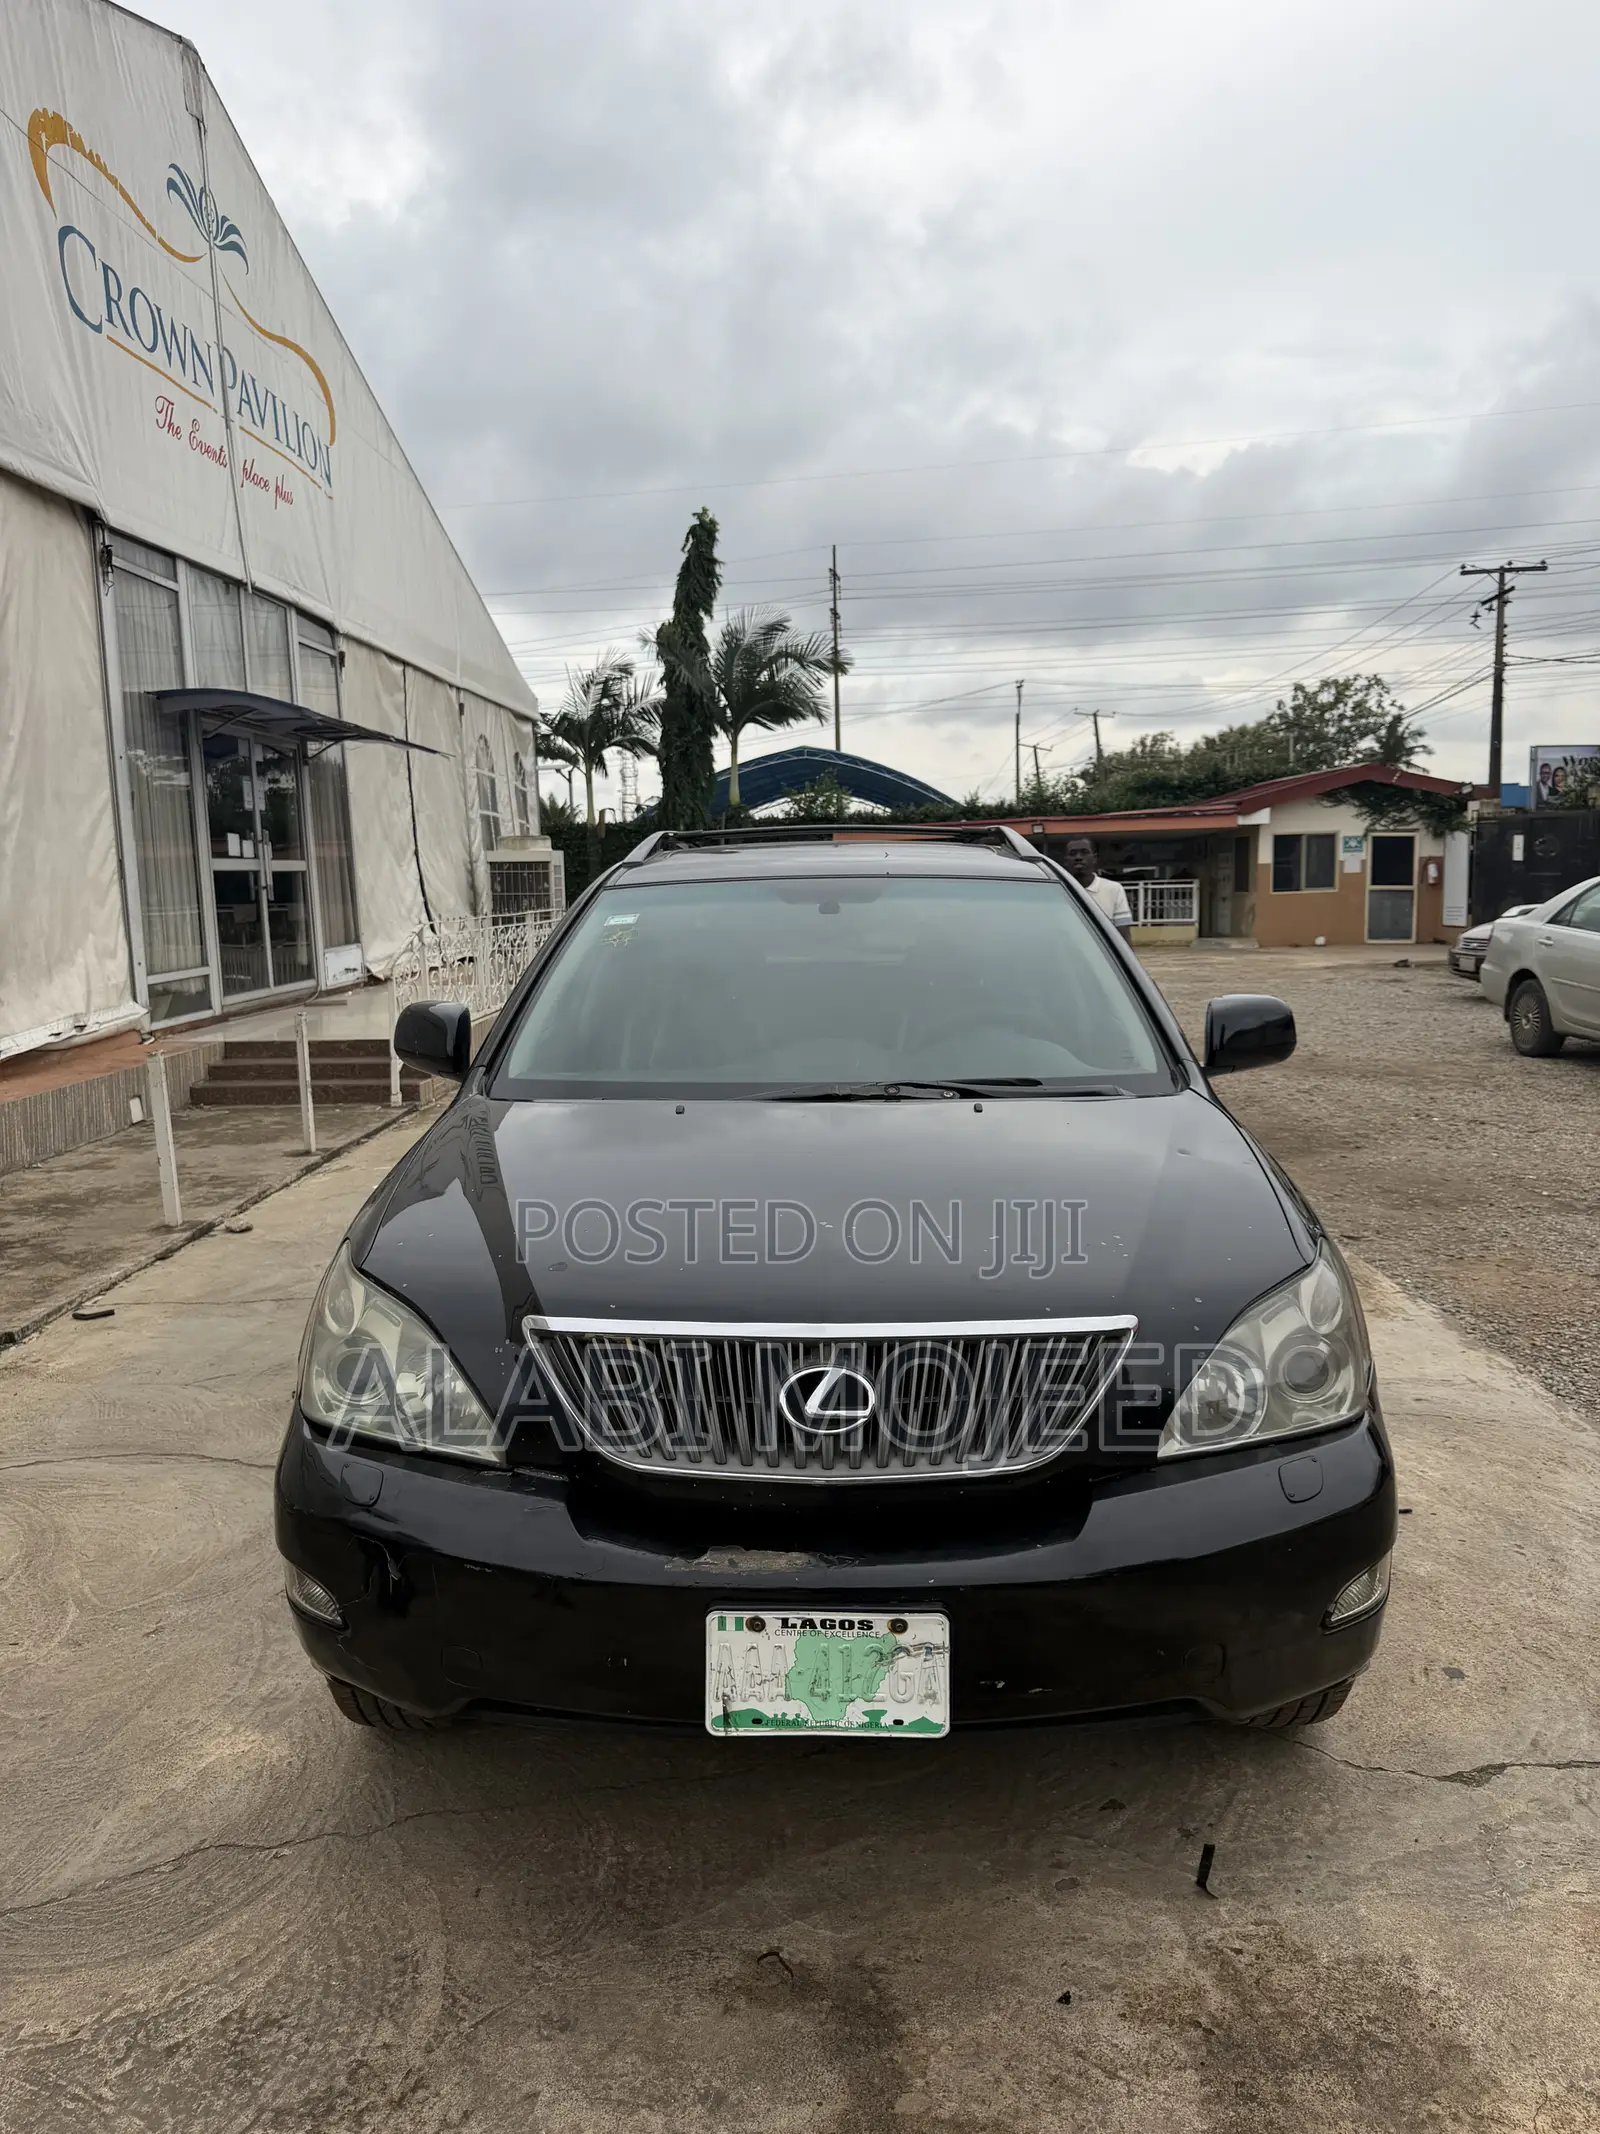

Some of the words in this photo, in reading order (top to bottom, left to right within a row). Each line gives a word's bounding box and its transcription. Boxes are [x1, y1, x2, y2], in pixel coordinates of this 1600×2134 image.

[58, 225, 215, 397] CROWN
[214, 340, 332, 489] PAVILION
[155, 395, 182, 440] The
[189, 418, 228, 468] Events
[240, 458, 270, 492] place
[274, 474, 294, 510] plus
[780, 1617, 874, 1631] LAGOS
[774, 1629, 807, 1637] CENTRE
[809, 1629, 821, 1637] OF
[824, 1630, 880, 1638] EXCELLENCE
[856, 1720, 889, 1729] NIGERIA
